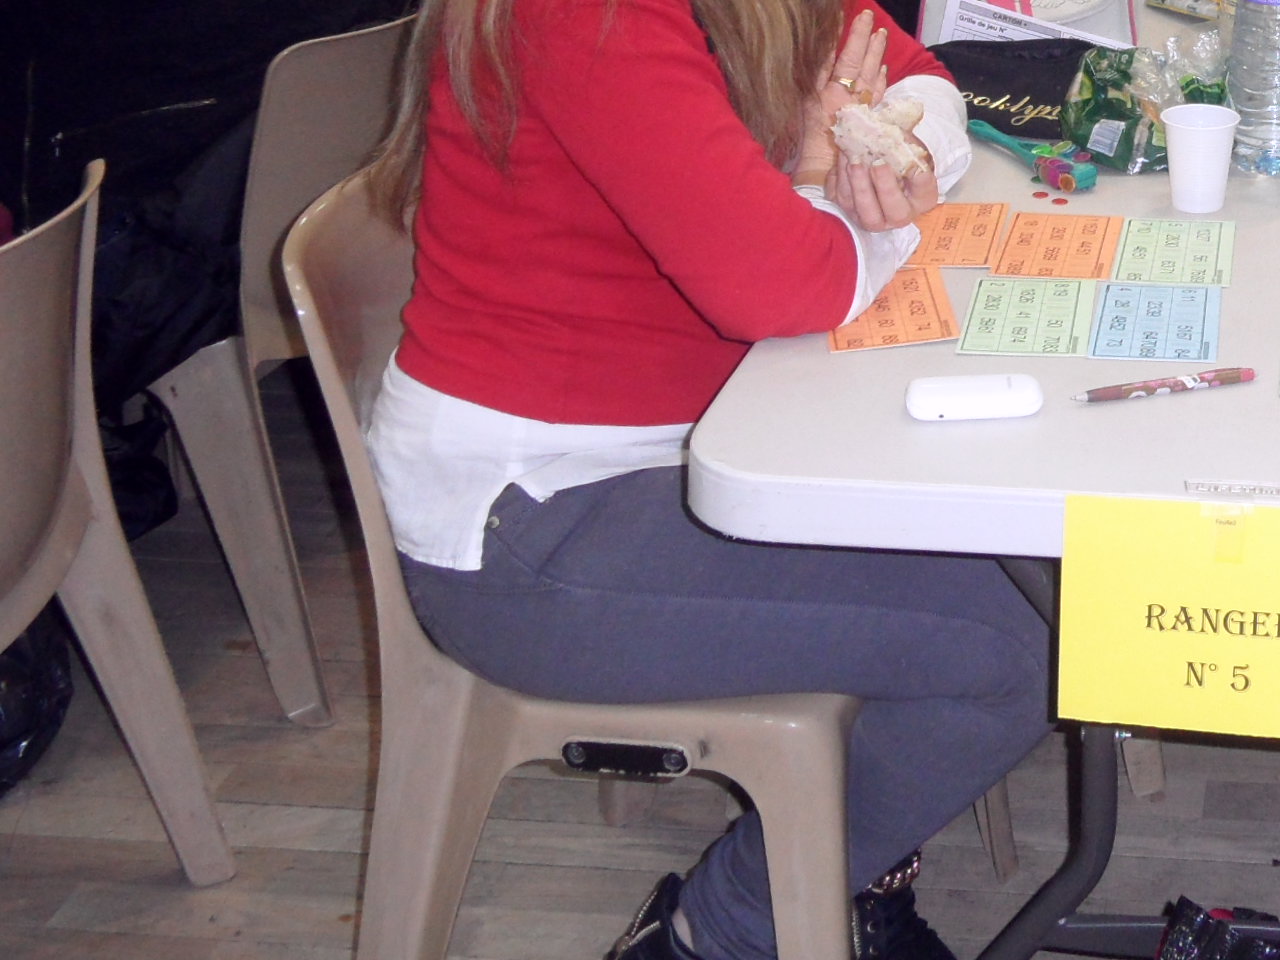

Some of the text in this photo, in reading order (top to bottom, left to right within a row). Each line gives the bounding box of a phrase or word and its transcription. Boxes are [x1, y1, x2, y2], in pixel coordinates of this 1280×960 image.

[992, 12, 1022, 26] CARTON
[1184, 661, 1251, 692] N° 5
